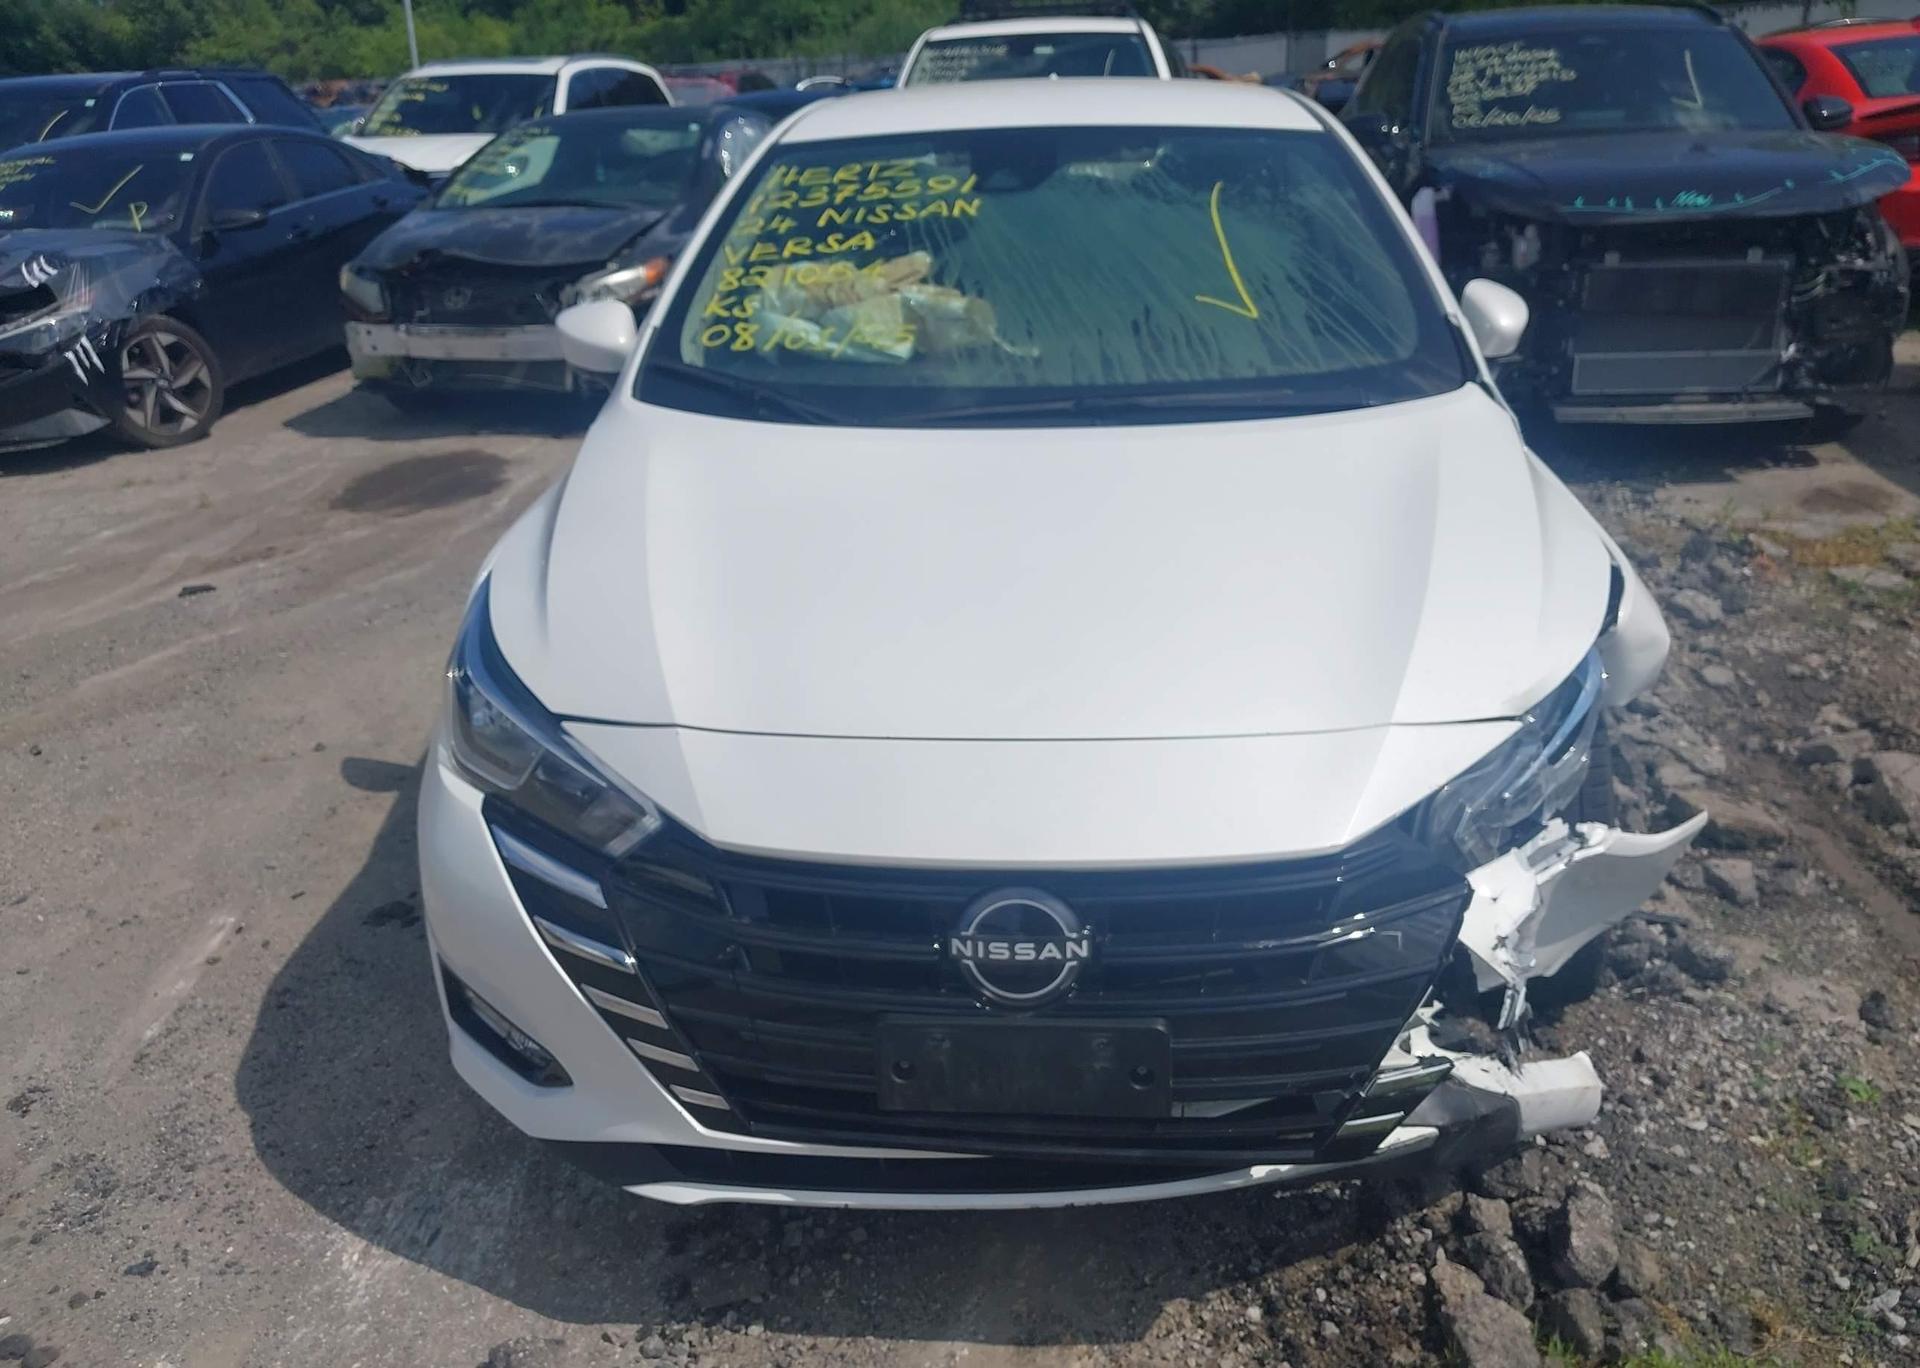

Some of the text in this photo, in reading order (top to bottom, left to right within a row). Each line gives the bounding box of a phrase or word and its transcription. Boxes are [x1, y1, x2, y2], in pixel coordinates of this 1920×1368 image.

[816, 198, 982, 228] NISSAN
[723, 230, 877, 264] VERSA
[951, 938, 1089, 961] NISSAN
